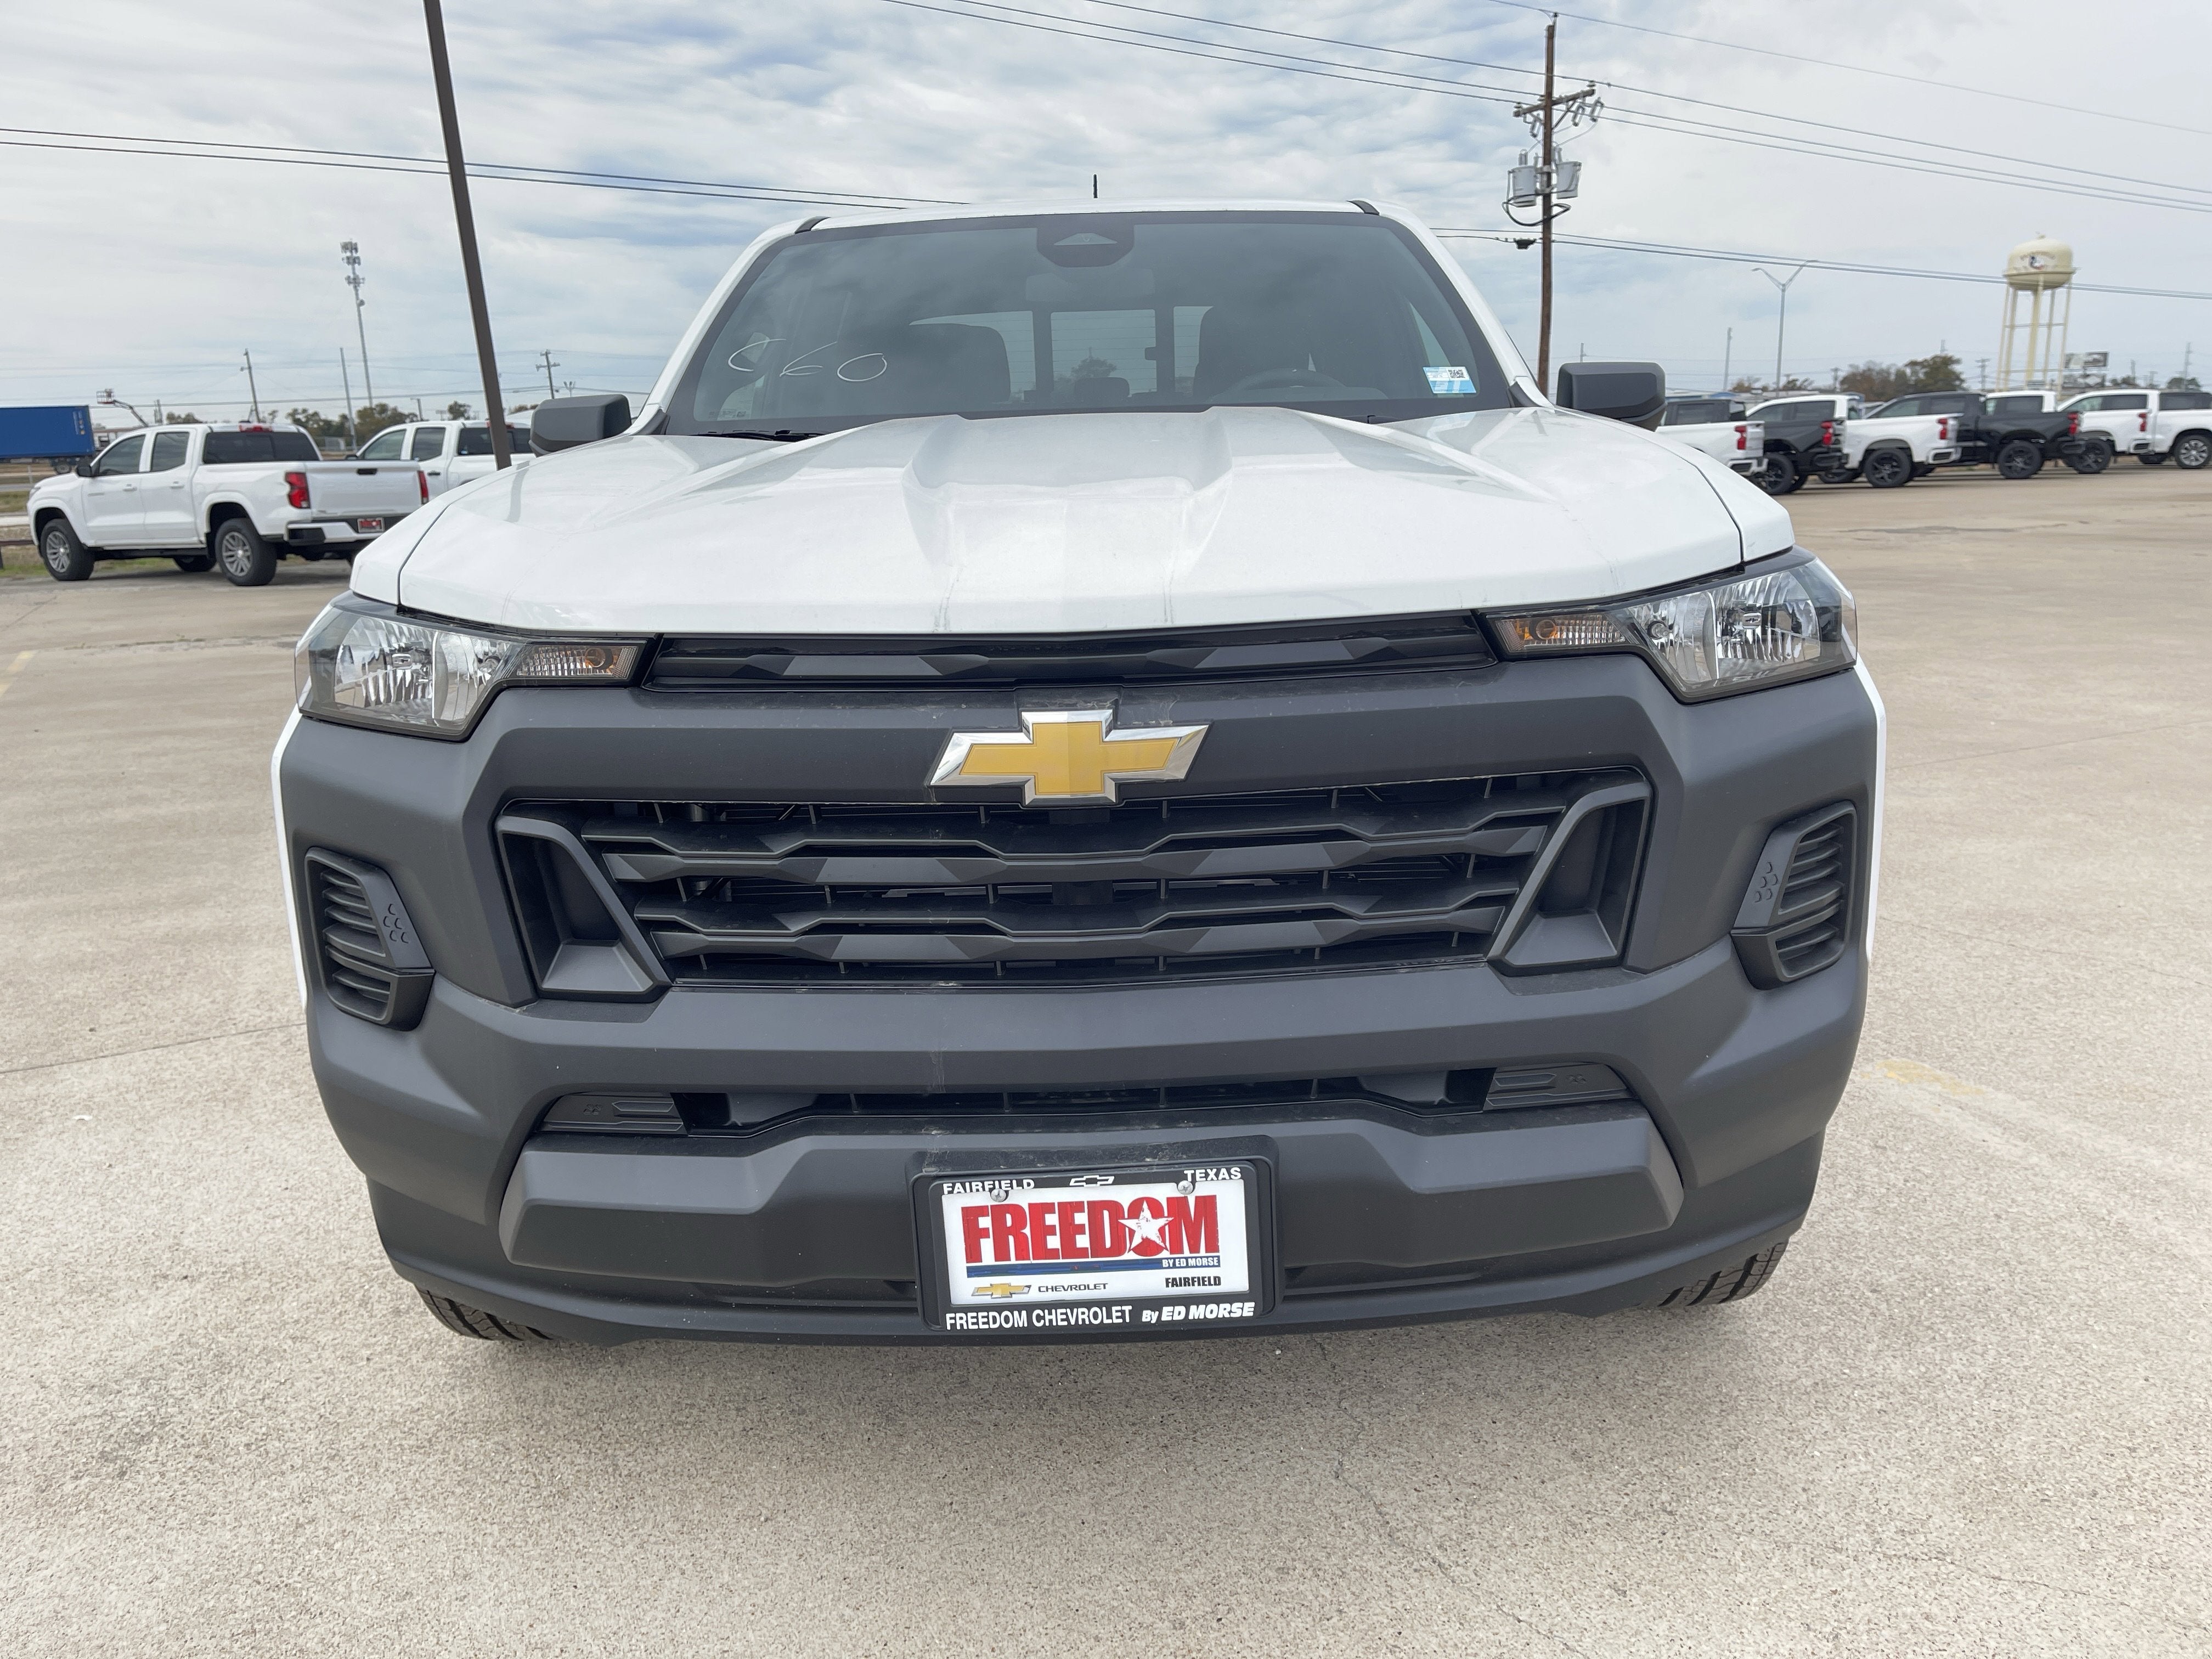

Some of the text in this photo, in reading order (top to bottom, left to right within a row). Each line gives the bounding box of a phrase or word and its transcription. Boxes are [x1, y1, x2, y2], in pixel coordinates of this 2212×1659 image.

[1183, 1167, 1242, 1182] TEXAS
[943, 1179, 1035, 1195] FAIRFIELD
[961, 1194, 1220, 1263] FREEDOM
[1162, 1256, 1219, 1268] BY ED MORSE
[1037, 1283, 1109, 1293] CHEVROLET
[1165, 1276, 1222, 1288] FAIRFIELD
[945, 1302, 1256, 1330] FREEDOM CHEVROLET By ED MORSE
